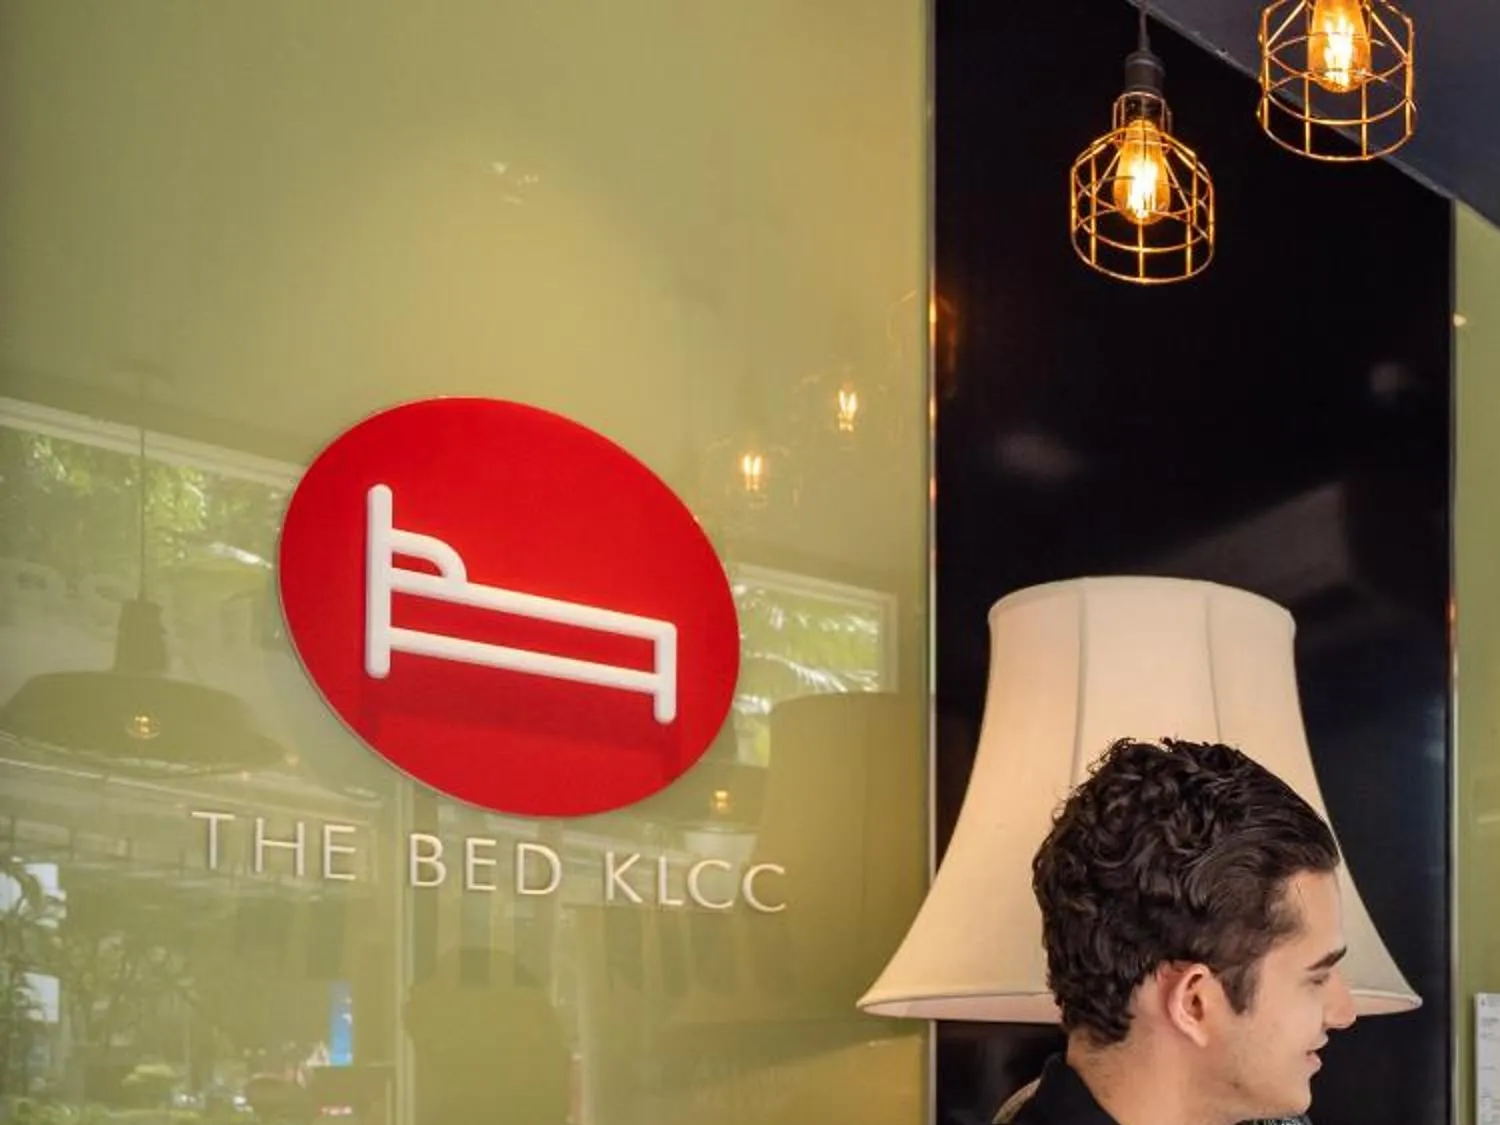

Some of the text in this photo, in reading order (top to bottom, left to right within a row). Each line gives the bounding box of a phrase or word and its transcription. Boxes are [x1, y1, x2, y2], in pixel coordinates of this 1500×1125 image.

[191, 810, 787, 913] THE BED KLCC
